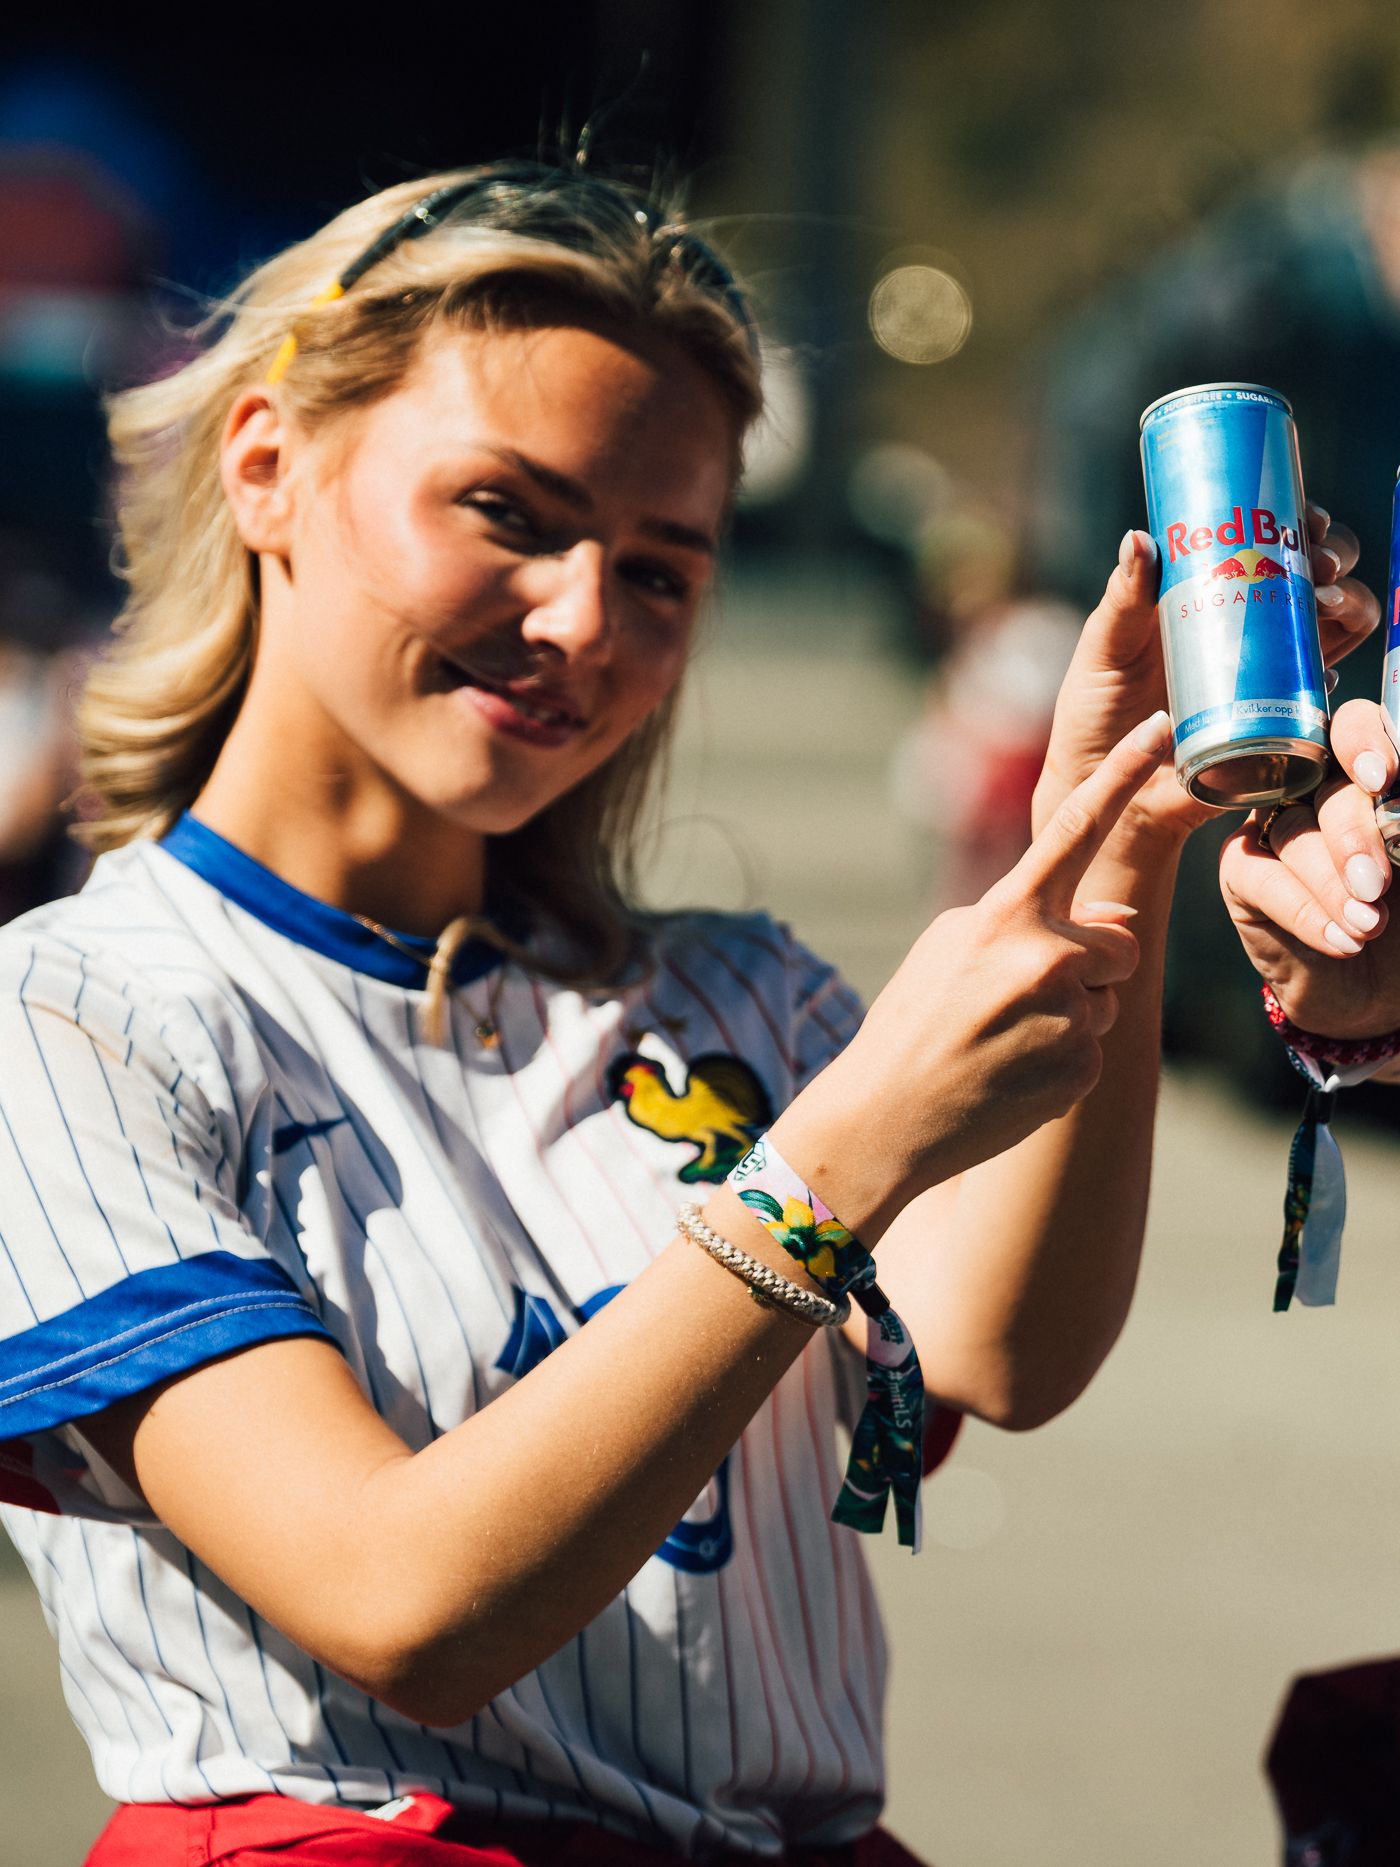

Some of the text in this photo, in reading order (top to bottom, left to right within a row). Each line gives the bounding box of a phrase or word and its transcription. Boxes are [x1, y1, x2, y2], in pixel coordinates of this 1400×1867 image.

[1166, 505, 1246, 564] Red
[1236, 704, 1272, 714] Kvikker
[1274, 705, 1293, 716] opp
